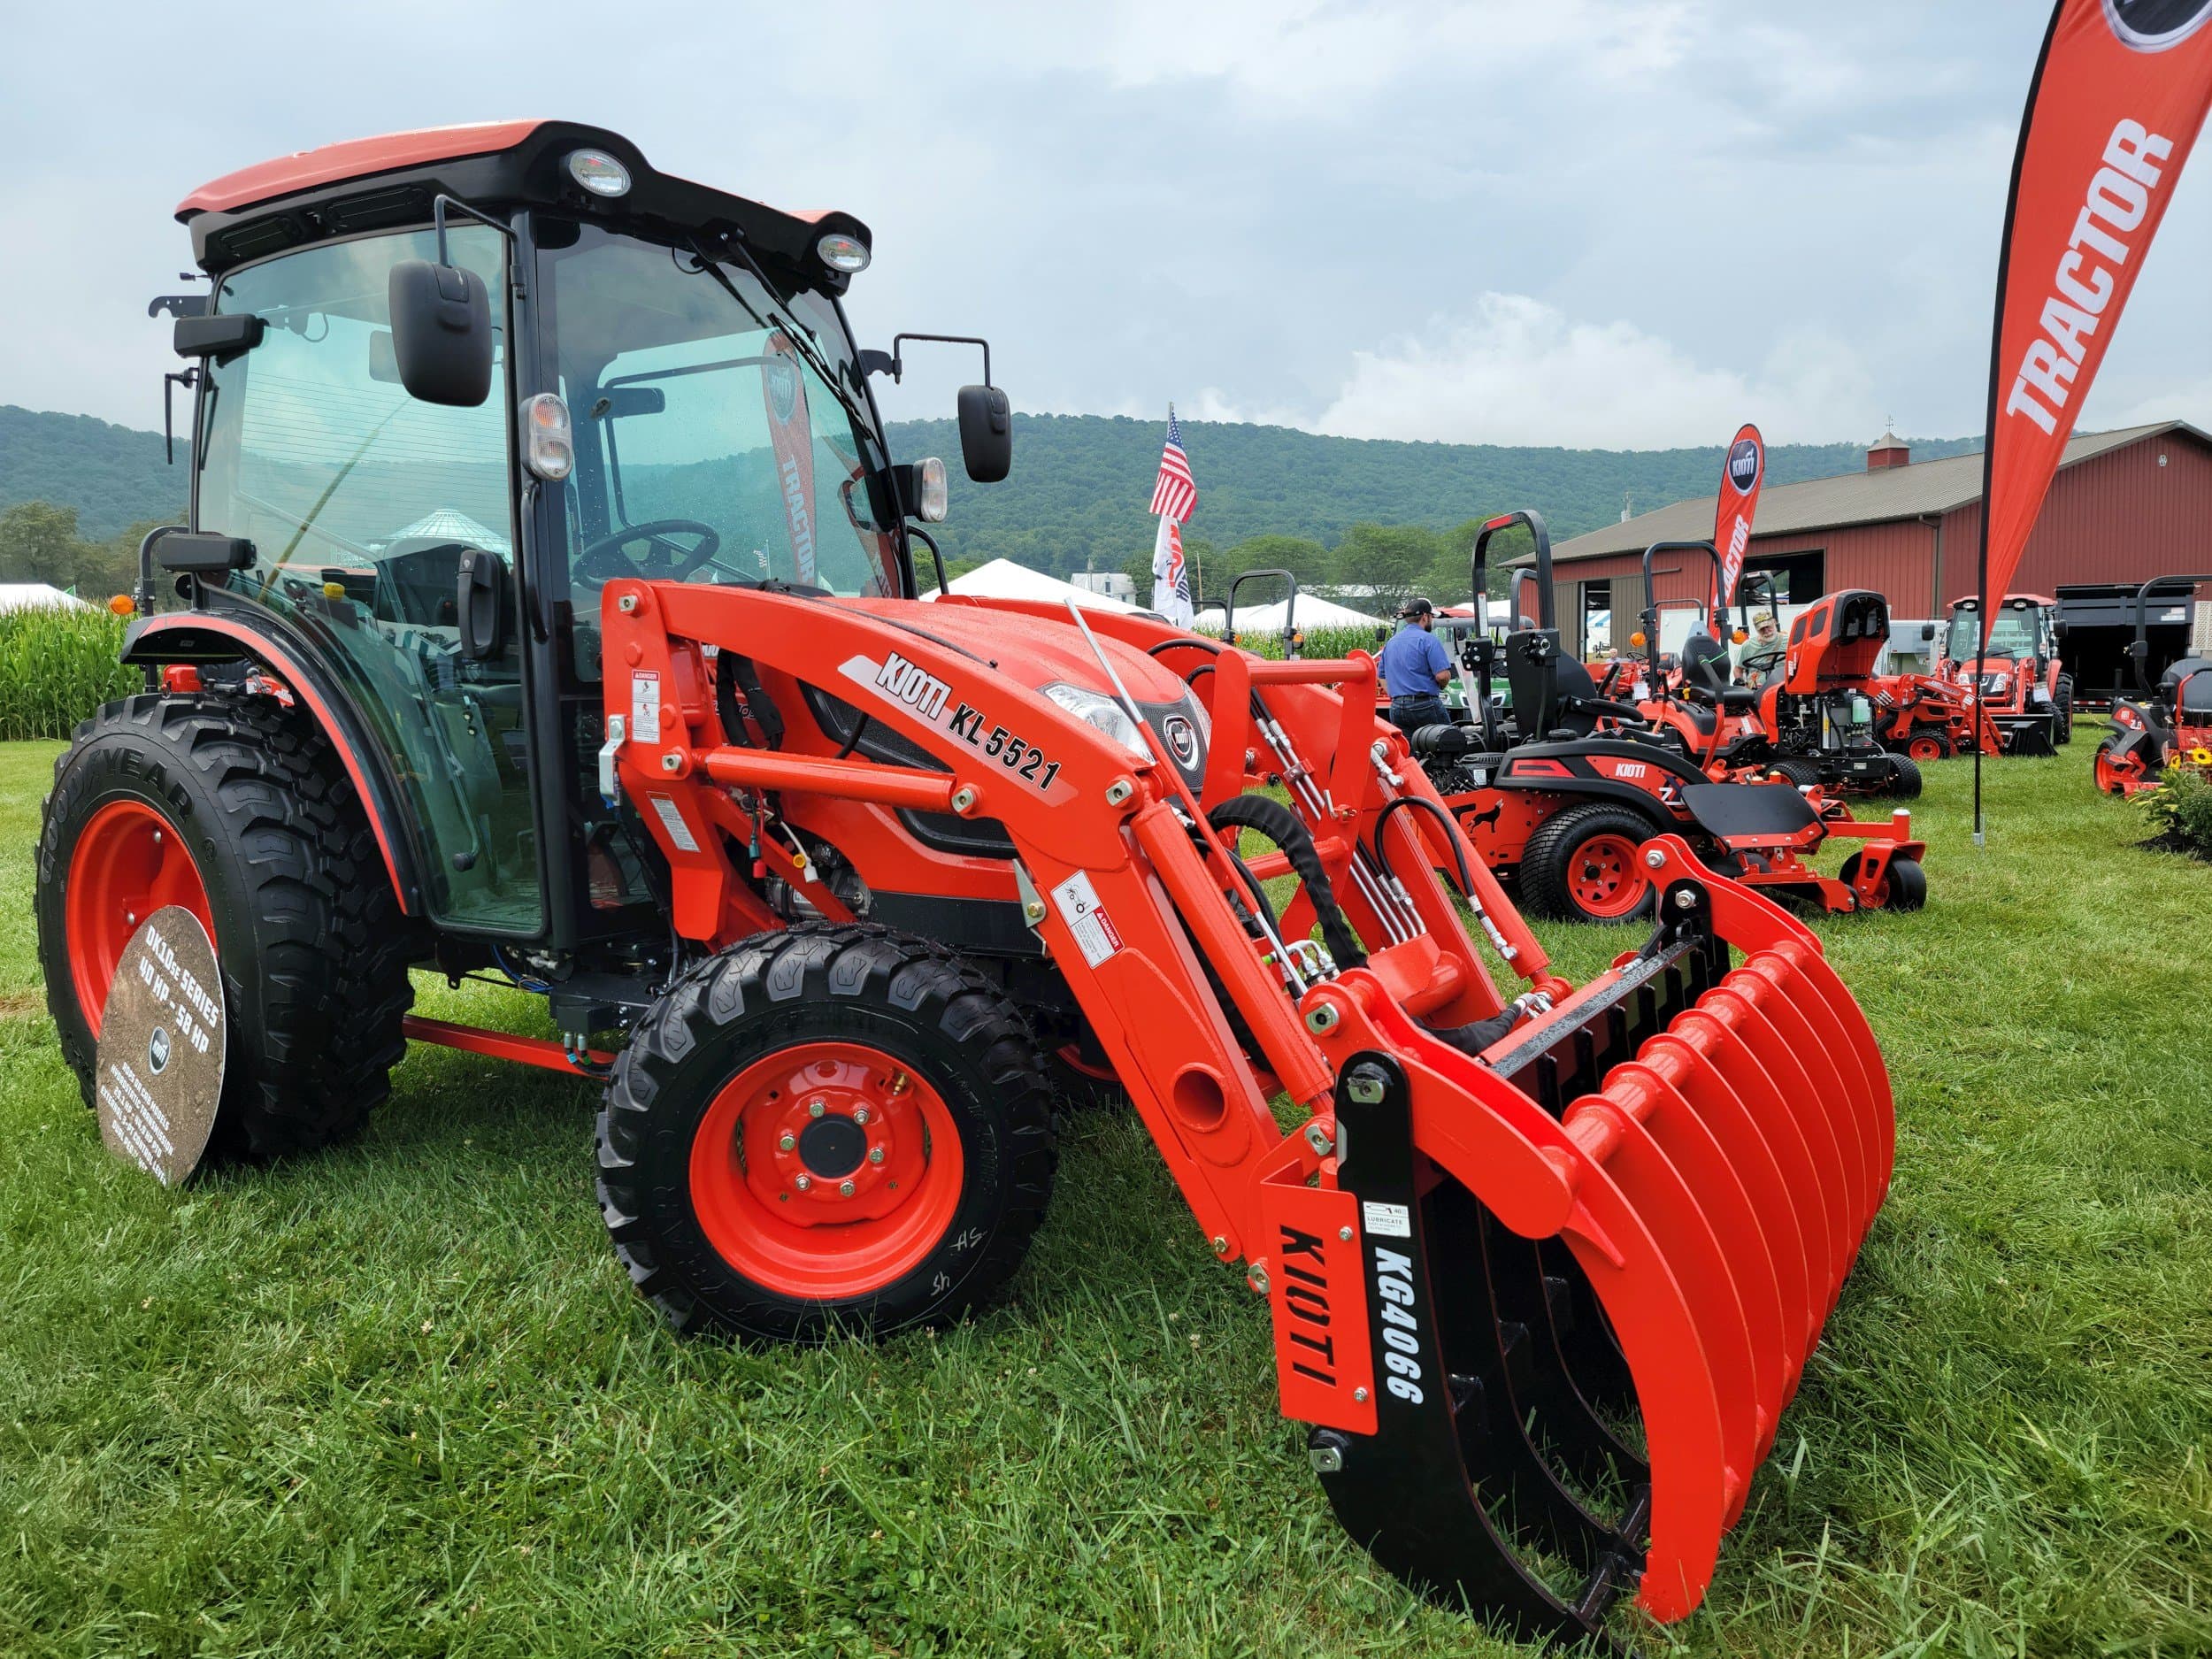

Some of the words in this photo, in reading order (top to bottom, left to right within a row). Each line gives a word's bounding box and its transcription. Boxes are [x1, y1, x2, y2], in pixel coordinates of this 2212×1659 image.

[2006, 119, 2174, 435] TRACTOR
[1732, 457, 1755, 478] KIOTI
[783, 454, 814, 583] TRACTOR
[1713, 514, 1749, 608] ACTOR
[875, 651, 953, 721] KIOTI
[1615, 763, 1647, 779] KIOTI
[1101, 918, 1120, 948] DANGER
[139, 956, 155, 986] 40
[152, 973, 170, 1002] HP
[191, 1024, 210, 1054] HP
[180, 969, 219, 1028] SERIES
[1367, 1217, 1403, 1225] LUBRICATE
[1280, 1225, 1337, 1387] KIOTI
[1375, 1246, 1424, 1405] KG4066
